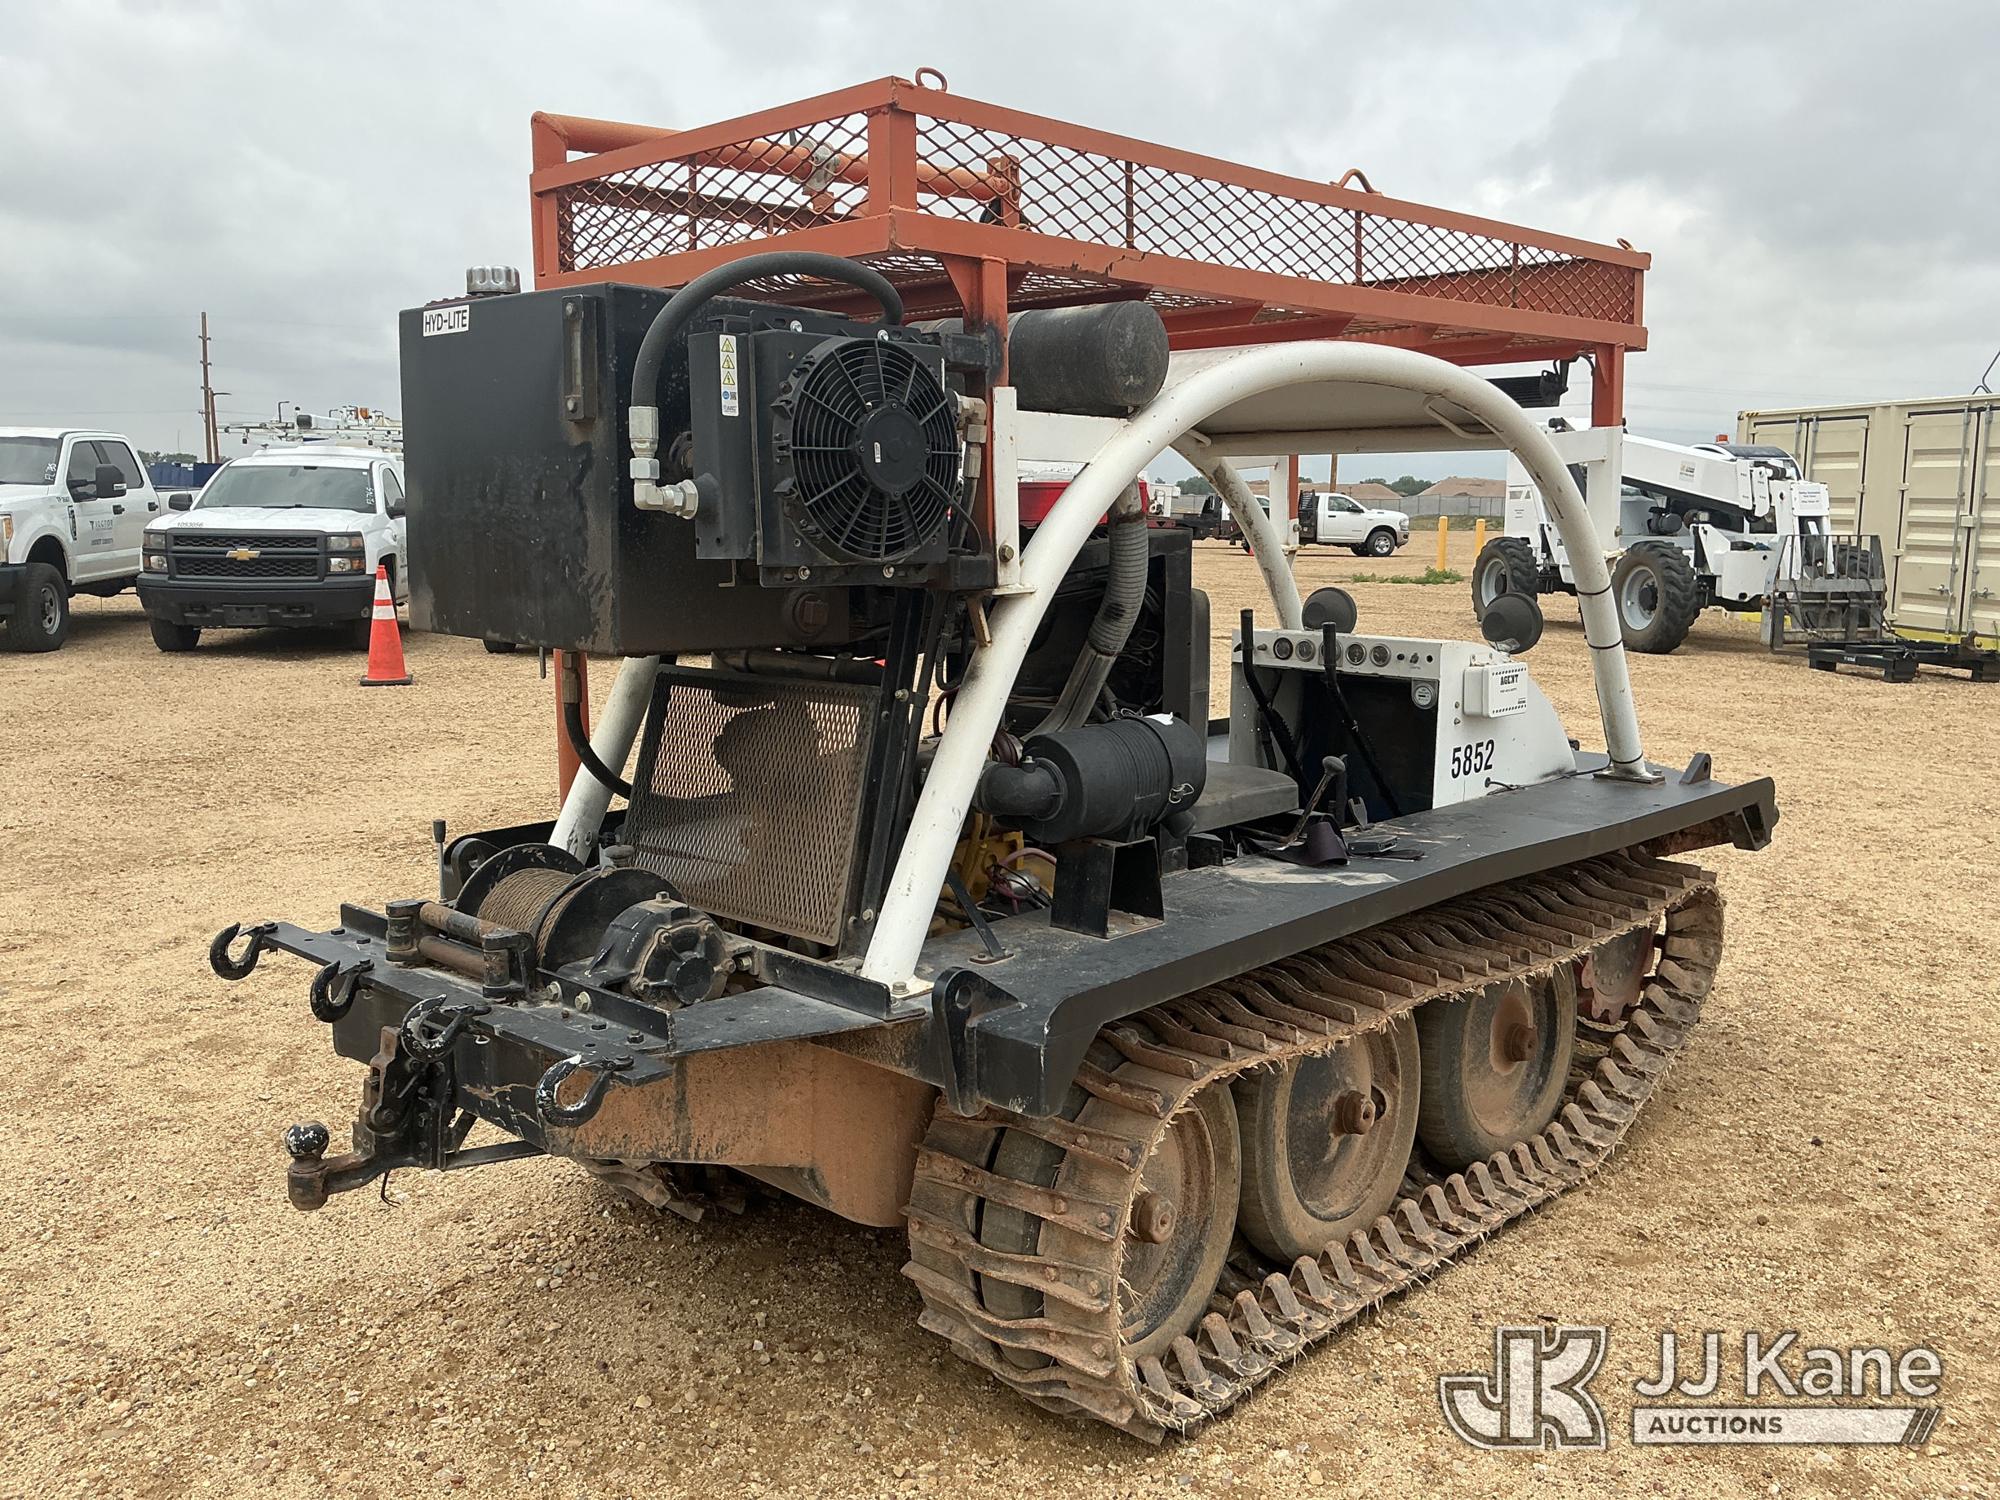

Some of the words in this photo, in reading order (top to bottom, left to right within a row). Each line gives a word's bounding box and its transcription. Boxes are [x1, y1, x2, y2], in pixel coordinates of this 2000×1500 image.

[425, 309, 468, 333] HYD-LITE
[1500, 674, 1519, 686] AGENT
[1451, 739, 1495, 779] 5852
